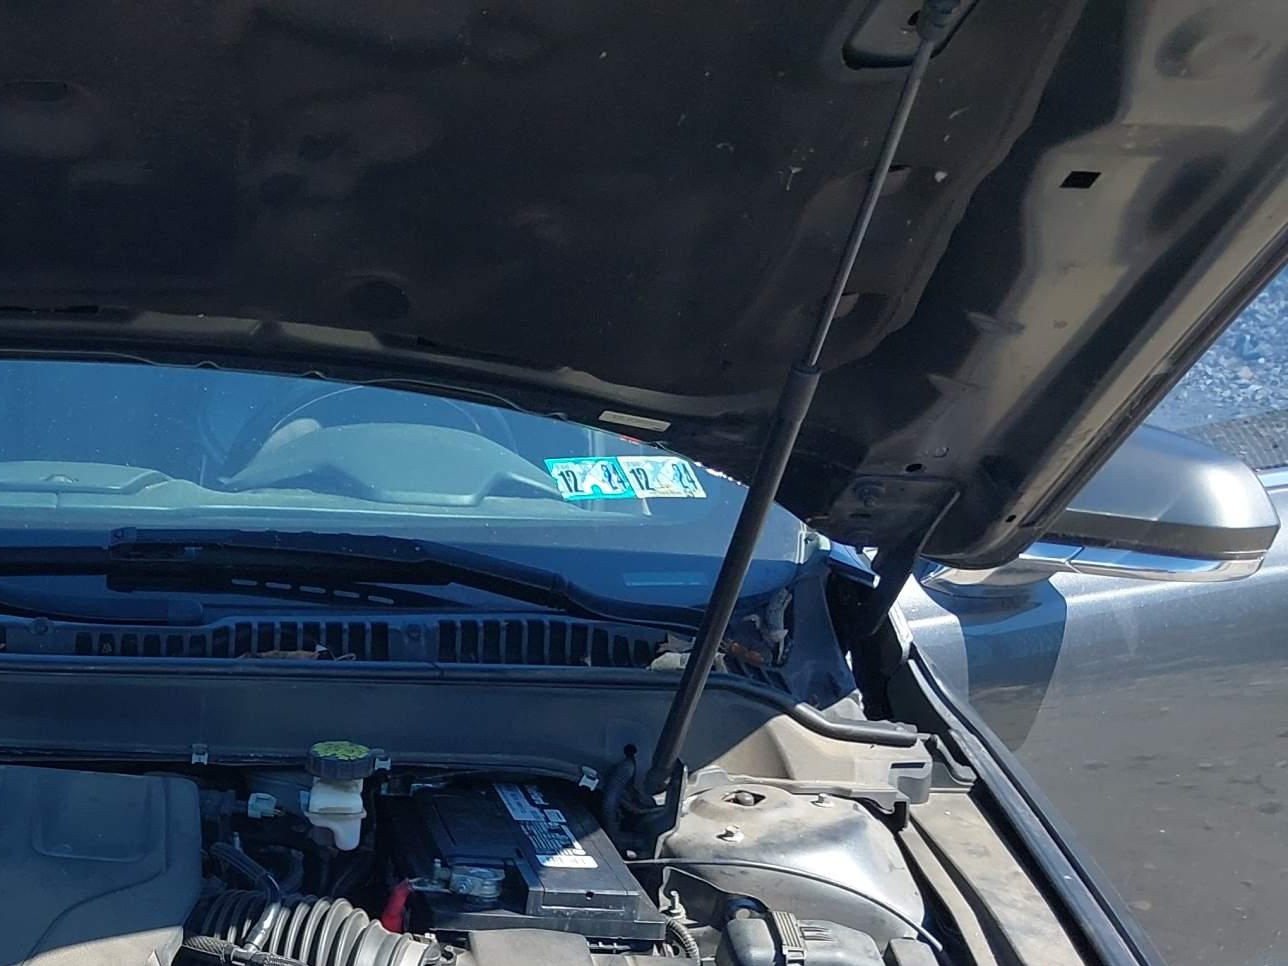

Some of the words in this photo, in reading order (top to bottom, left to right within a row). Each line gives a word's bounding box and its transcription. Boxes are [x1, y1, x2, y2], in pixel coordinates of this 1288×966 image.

[558, 470, 584, 492] 12
[602, 465, 626, 489] 24
[630, 468, 655, 491] 12
[672, 464, 698, 489] 24
